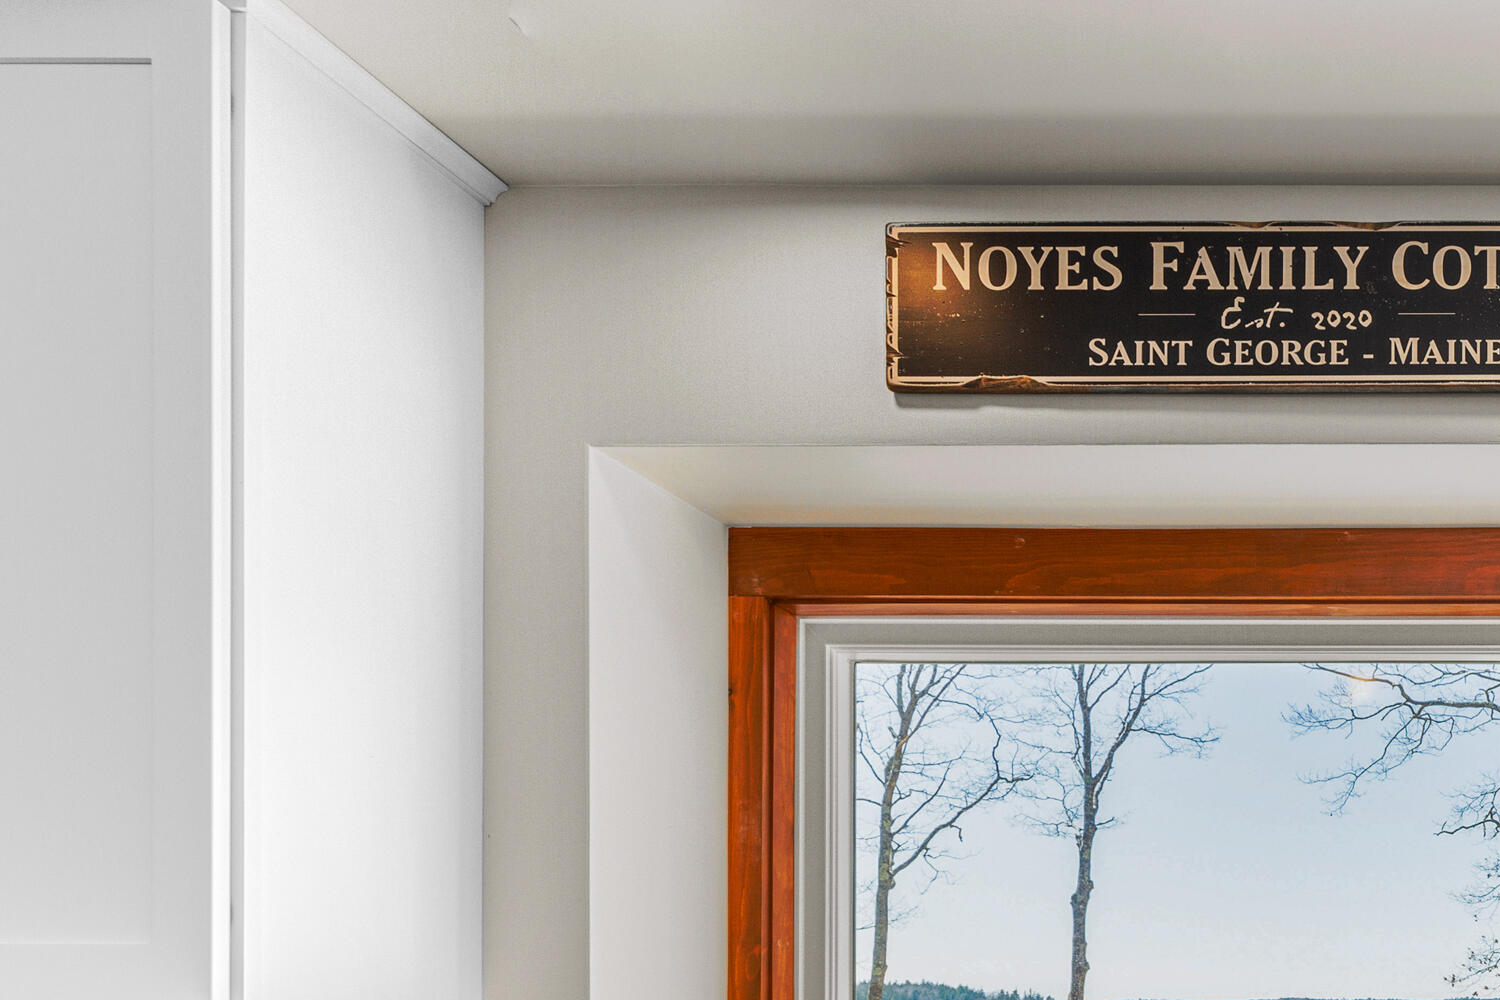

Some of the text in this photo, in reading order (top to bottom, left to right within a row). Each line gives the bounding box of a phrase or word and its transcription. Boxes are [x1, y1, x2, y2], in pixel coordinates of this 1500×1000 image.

[931, 241, 1123, 291] NOYES
[1149, 241, 1368, 291] FAMILY
[1220, 296, 1373, 331] Est. 2020
[1088, 337, 1193, 367] SAINT
[1206, 337, 1349, 366] GEORGE
